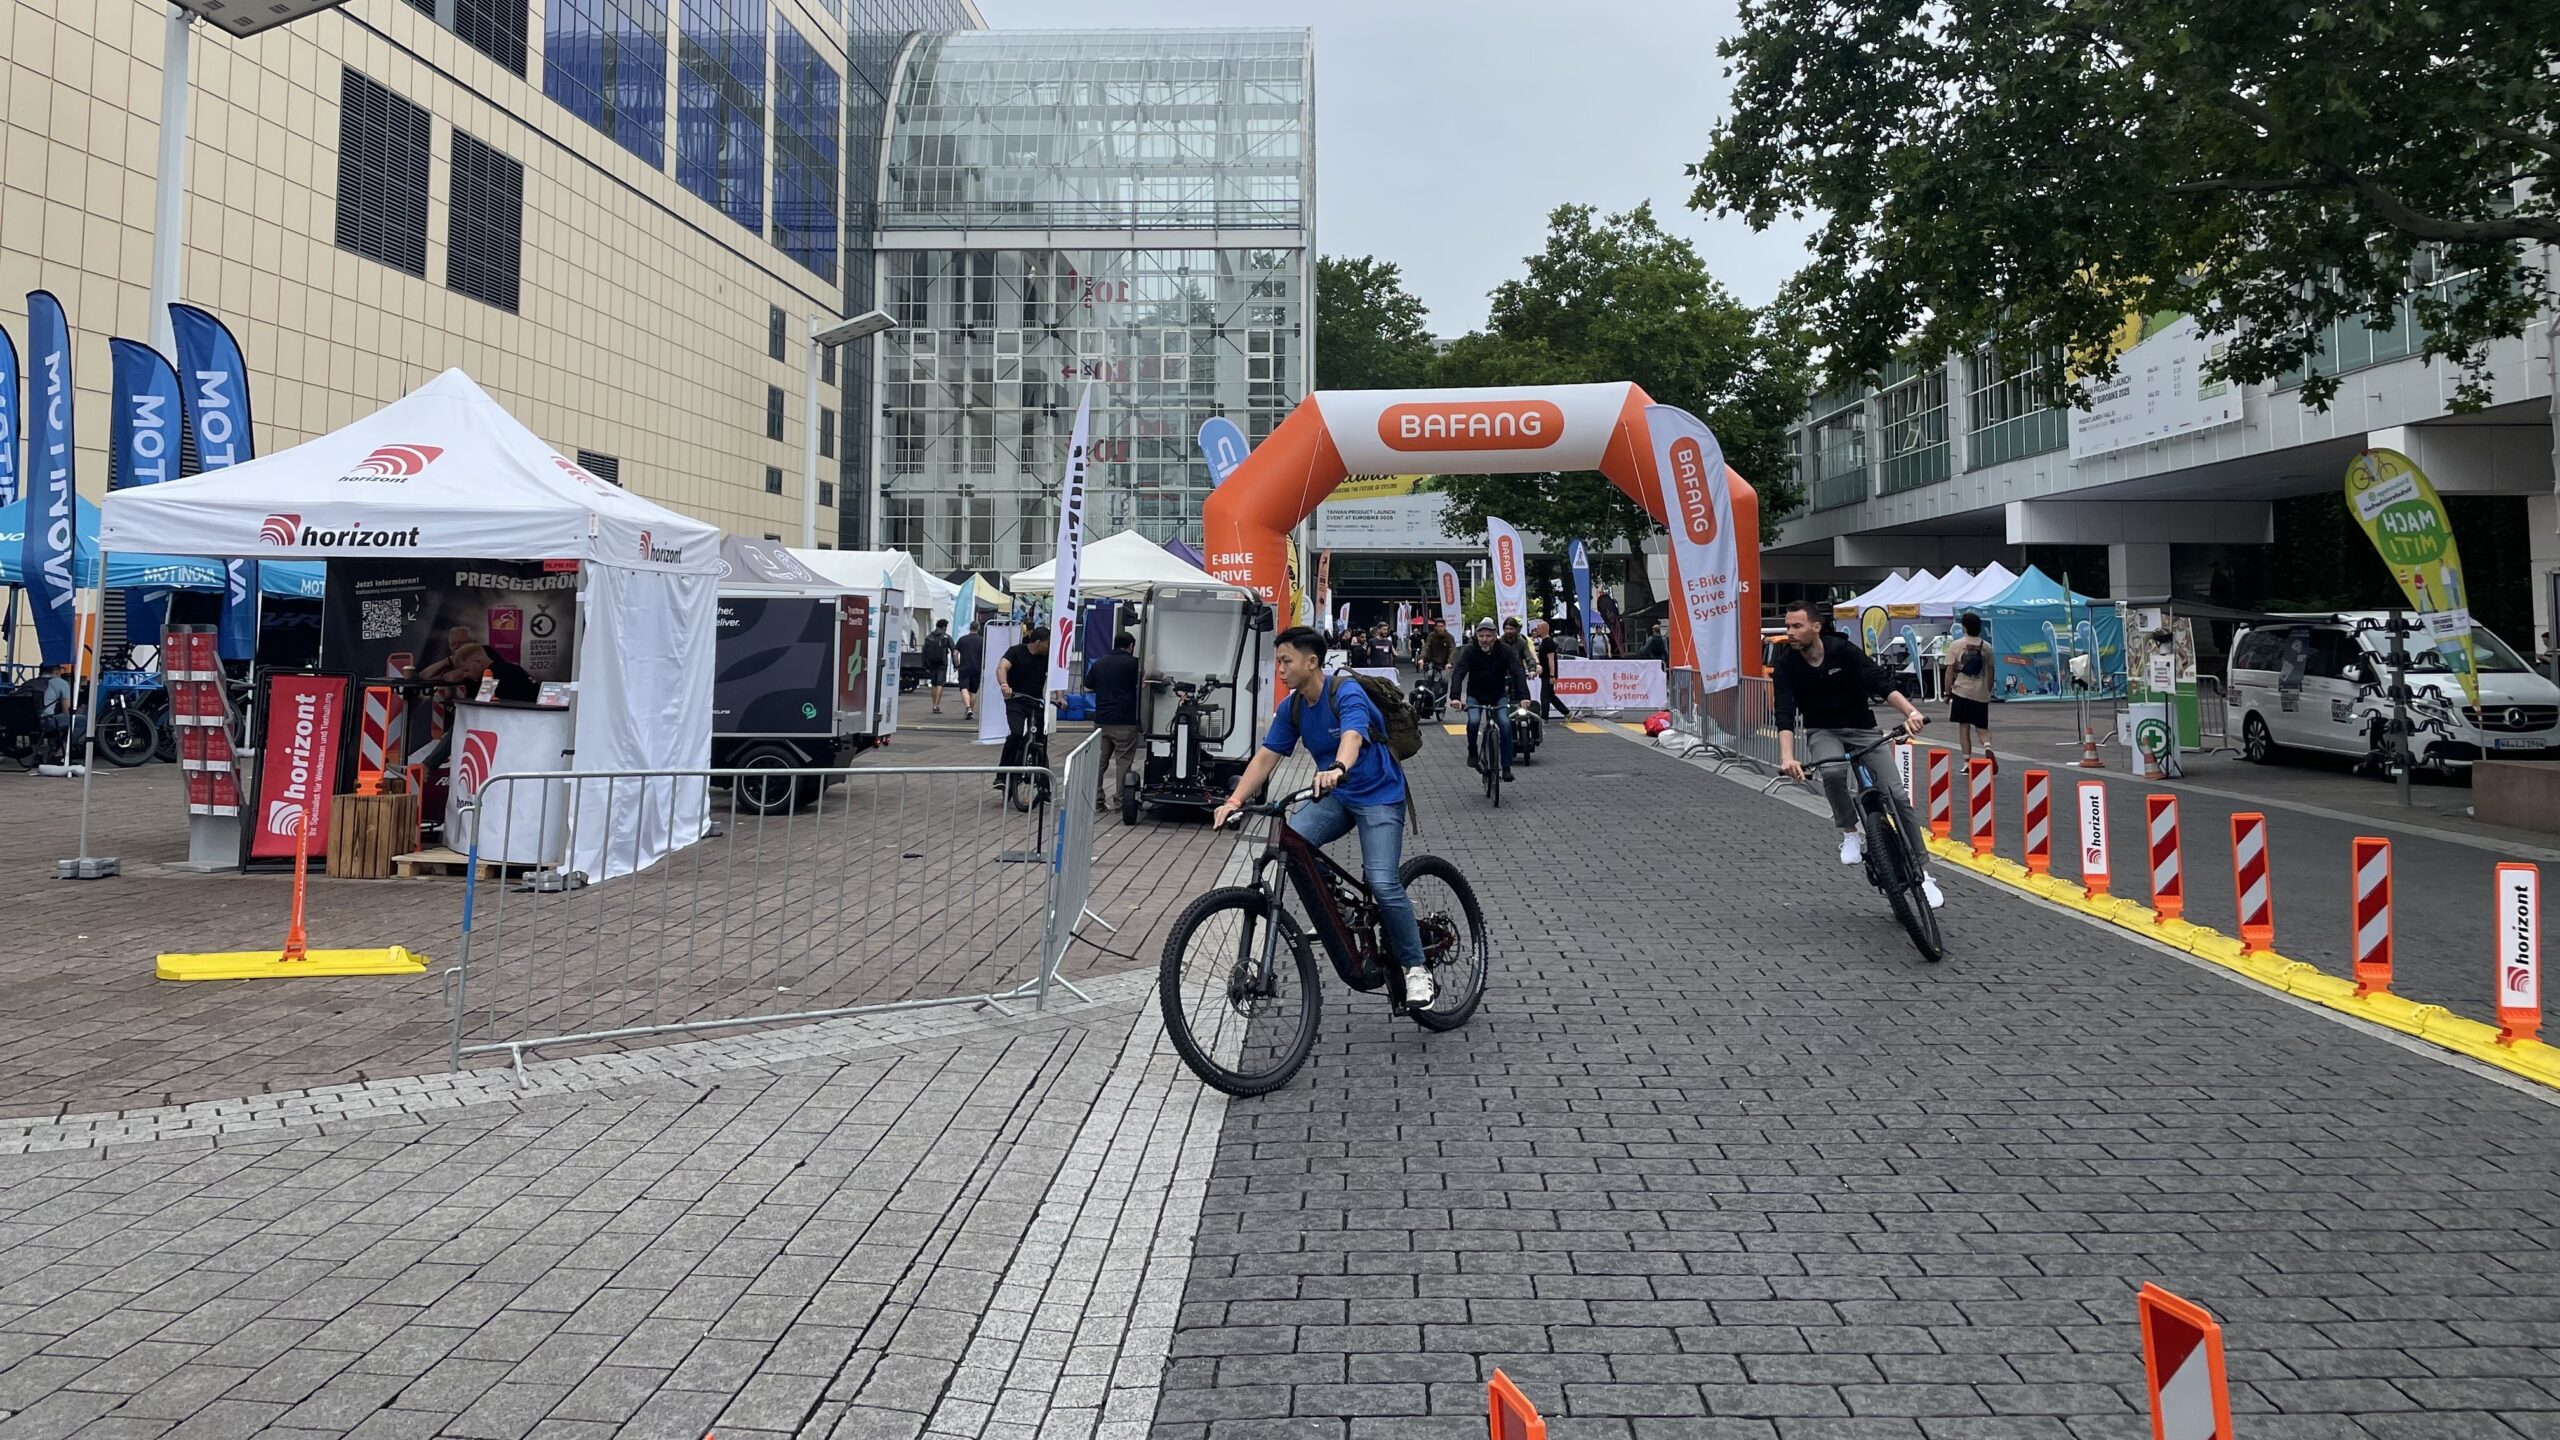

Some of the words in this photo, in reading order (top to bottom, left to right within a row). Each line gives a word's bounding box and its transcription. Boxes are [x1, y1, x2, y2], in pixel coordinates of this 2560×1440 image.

[1400, 411, 1541, 438] BAFANG
[337, 474, 408, 484] horizont
[1678, 448, 1709, 533] BAFANG
[301, 521, 420, 548] horizont
[650, 540, 683, 565] horizont
[1212, 552, 1254, 566] E-BIKE
[1501, 541, 1513, 581] BAFANG
[143, 565, 217, 583] MOTINOVA
[1212, 569, 1252, 581] DRIVE
[1687, 573, 1727, 592] E-Bike
[1690, 589, 1725, 606] Drive
[1612, 672, 1640, 680] E-Bike
[1612, 682, 1637, 690] Drive
[1612, 691, 1649, 701] Systems
[321, 693, 333, 731] Tierhaltung
[284, 694, 316, 799] horizont
[1901, 750, 1911, 793] horizont
[2091, 795, 2101, 848] horizont
[2515, 884, 2531, 966] horizont
